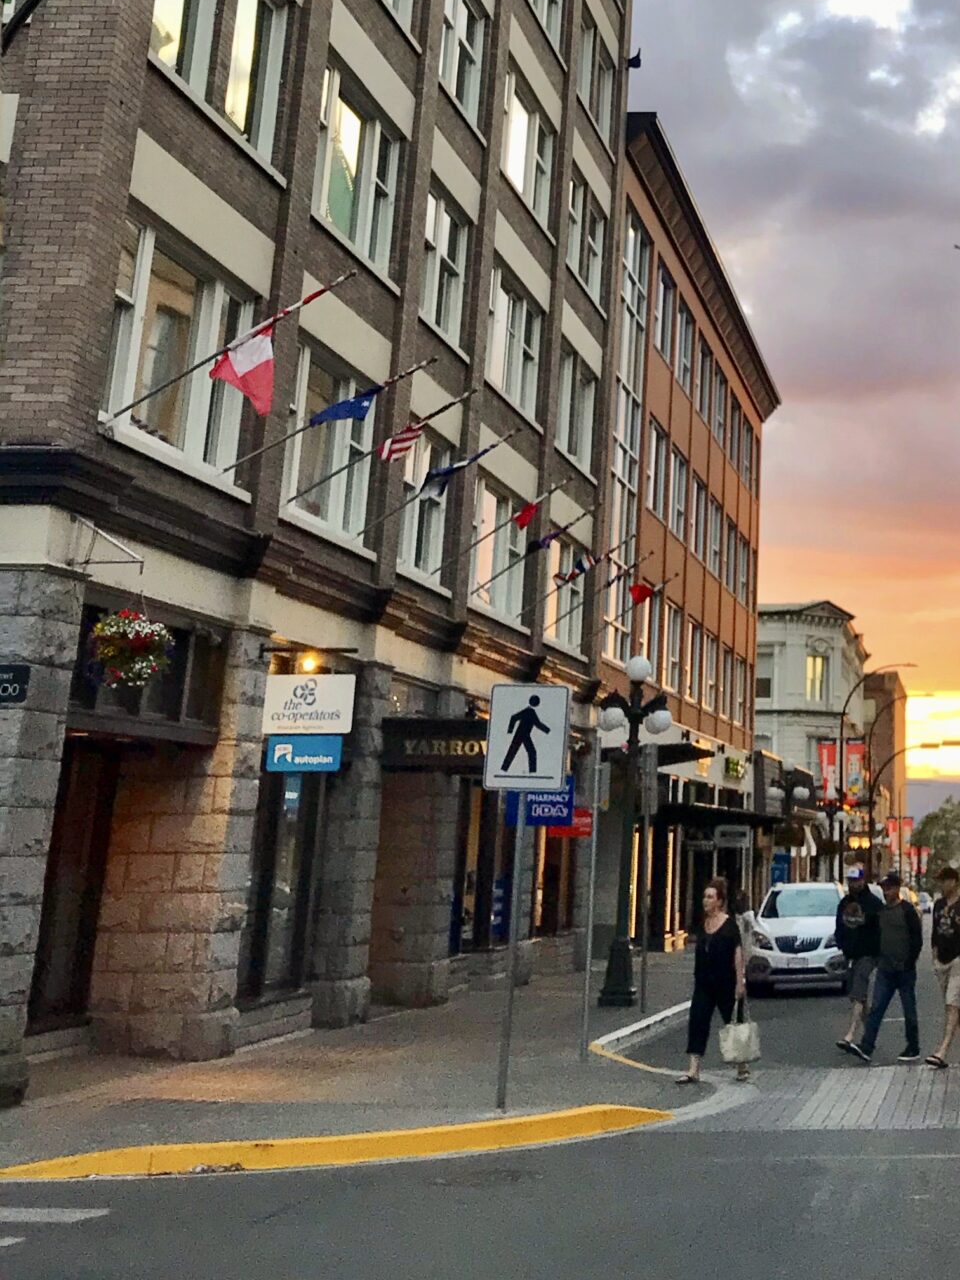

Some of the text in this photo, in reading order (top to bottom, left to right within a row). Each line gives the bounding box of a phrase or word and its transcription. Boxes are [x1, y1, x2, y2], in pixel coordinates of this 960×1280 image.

[283, 699, 302, 711] the
[271, 709, 341, 723] co-operators
[294, 755, 333, 765] autoplan
[527, 793, 570, 802] PHARMACY
